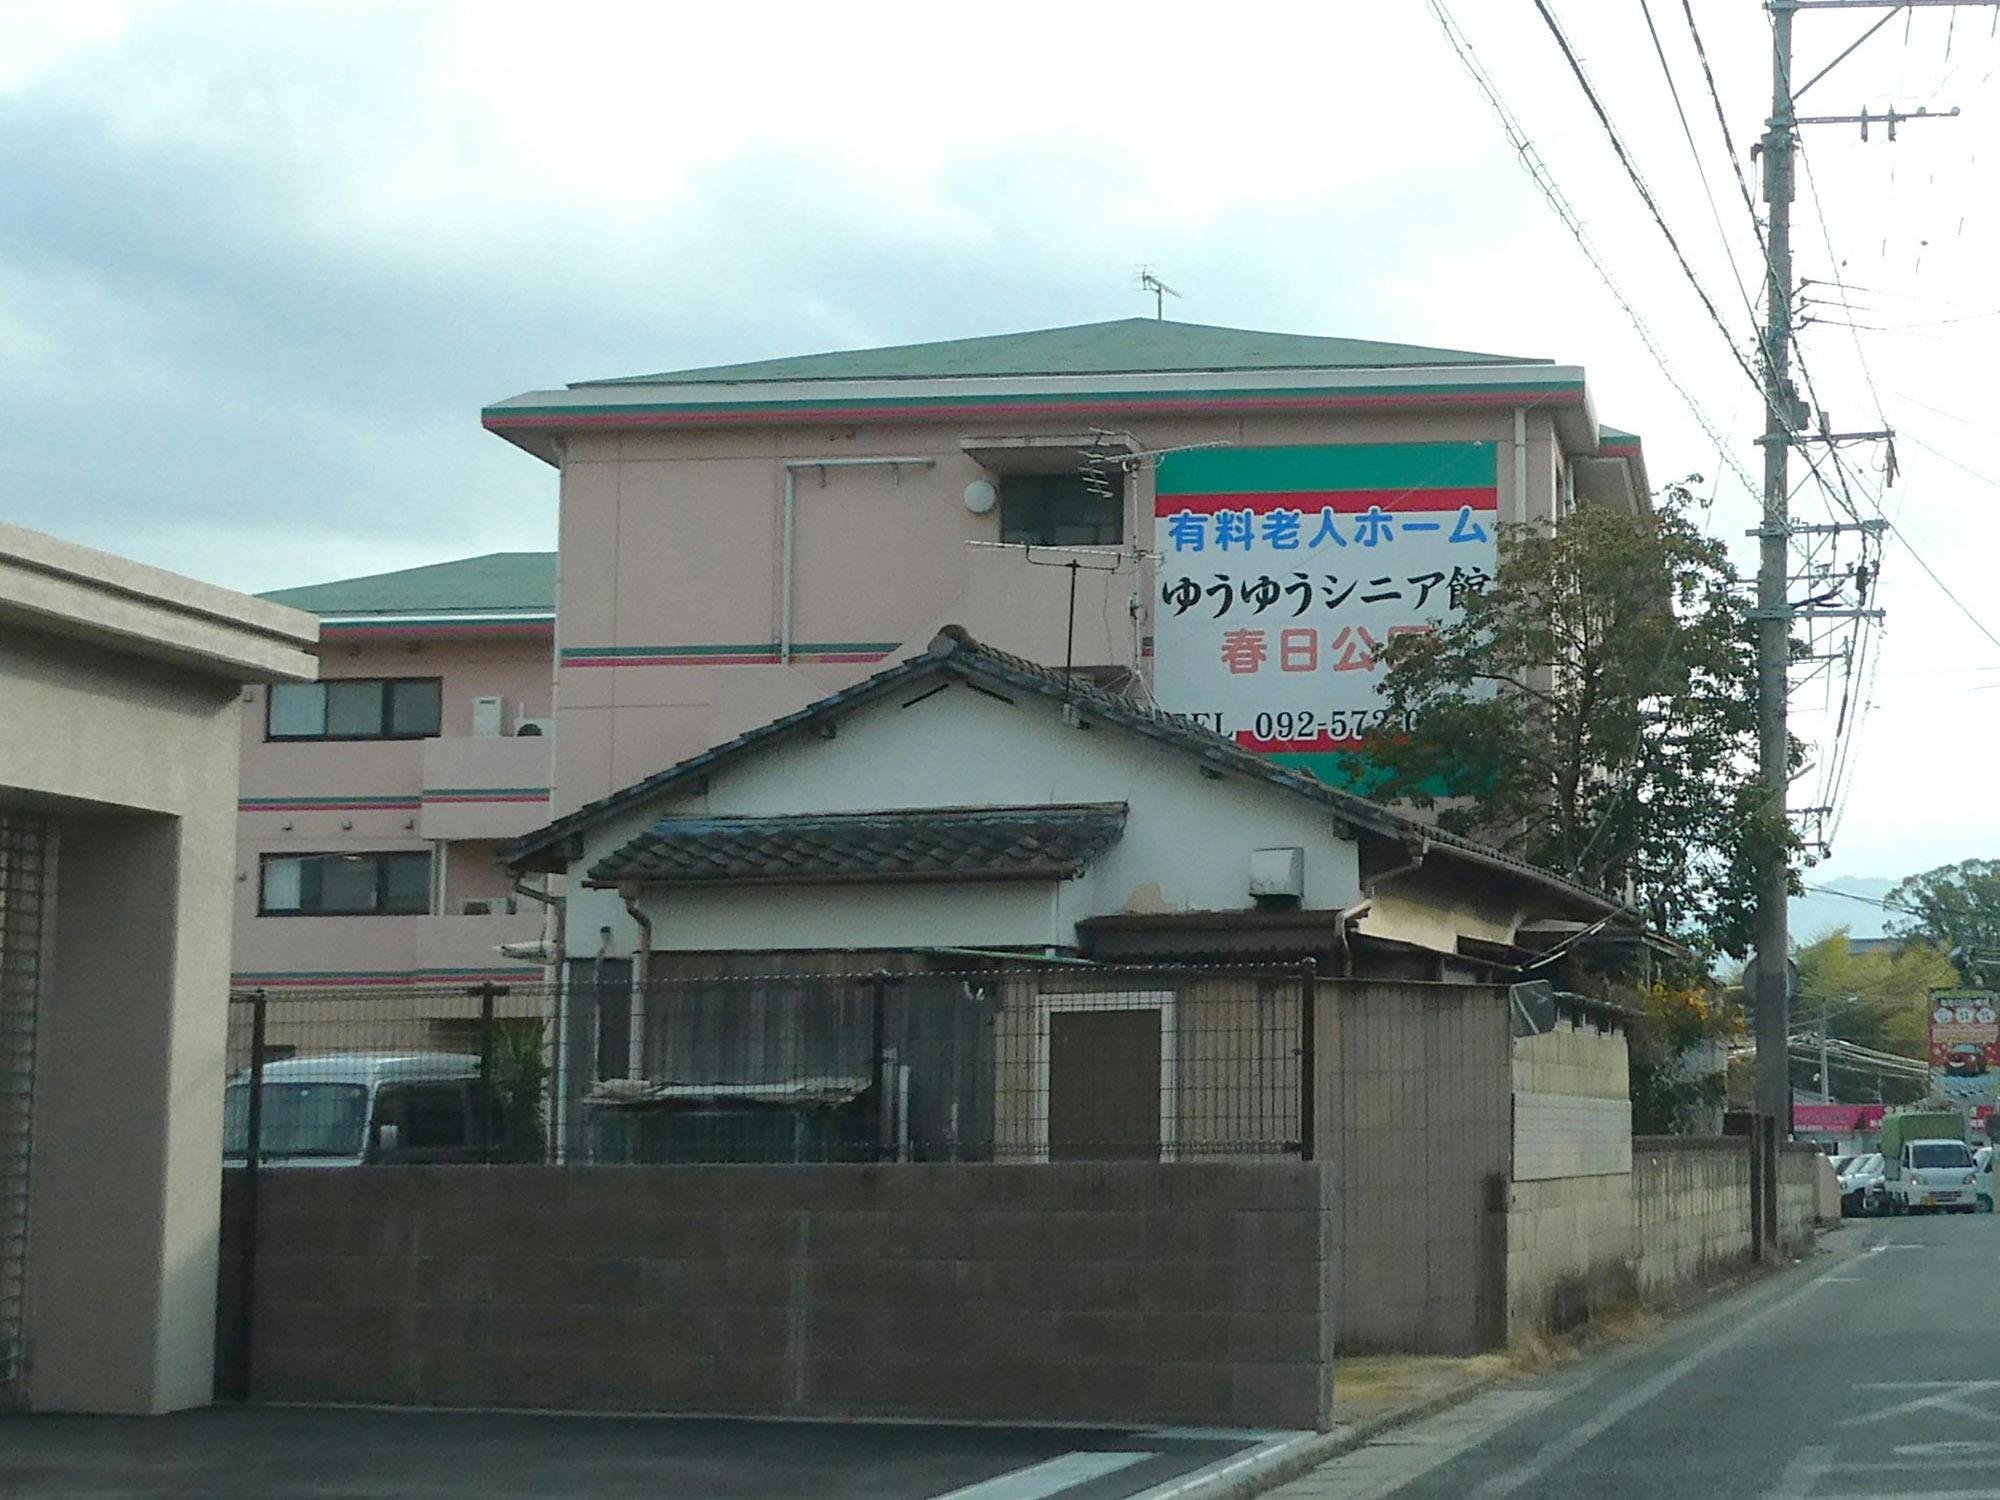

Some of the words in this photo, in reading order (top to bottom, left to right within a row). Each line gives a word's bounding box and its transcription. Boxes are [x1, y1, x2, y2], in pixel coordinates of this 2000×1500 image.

[1168, 507, 1488, 551] 有料老人ホーム
[1221, 625, 1433, 674] 春日公
